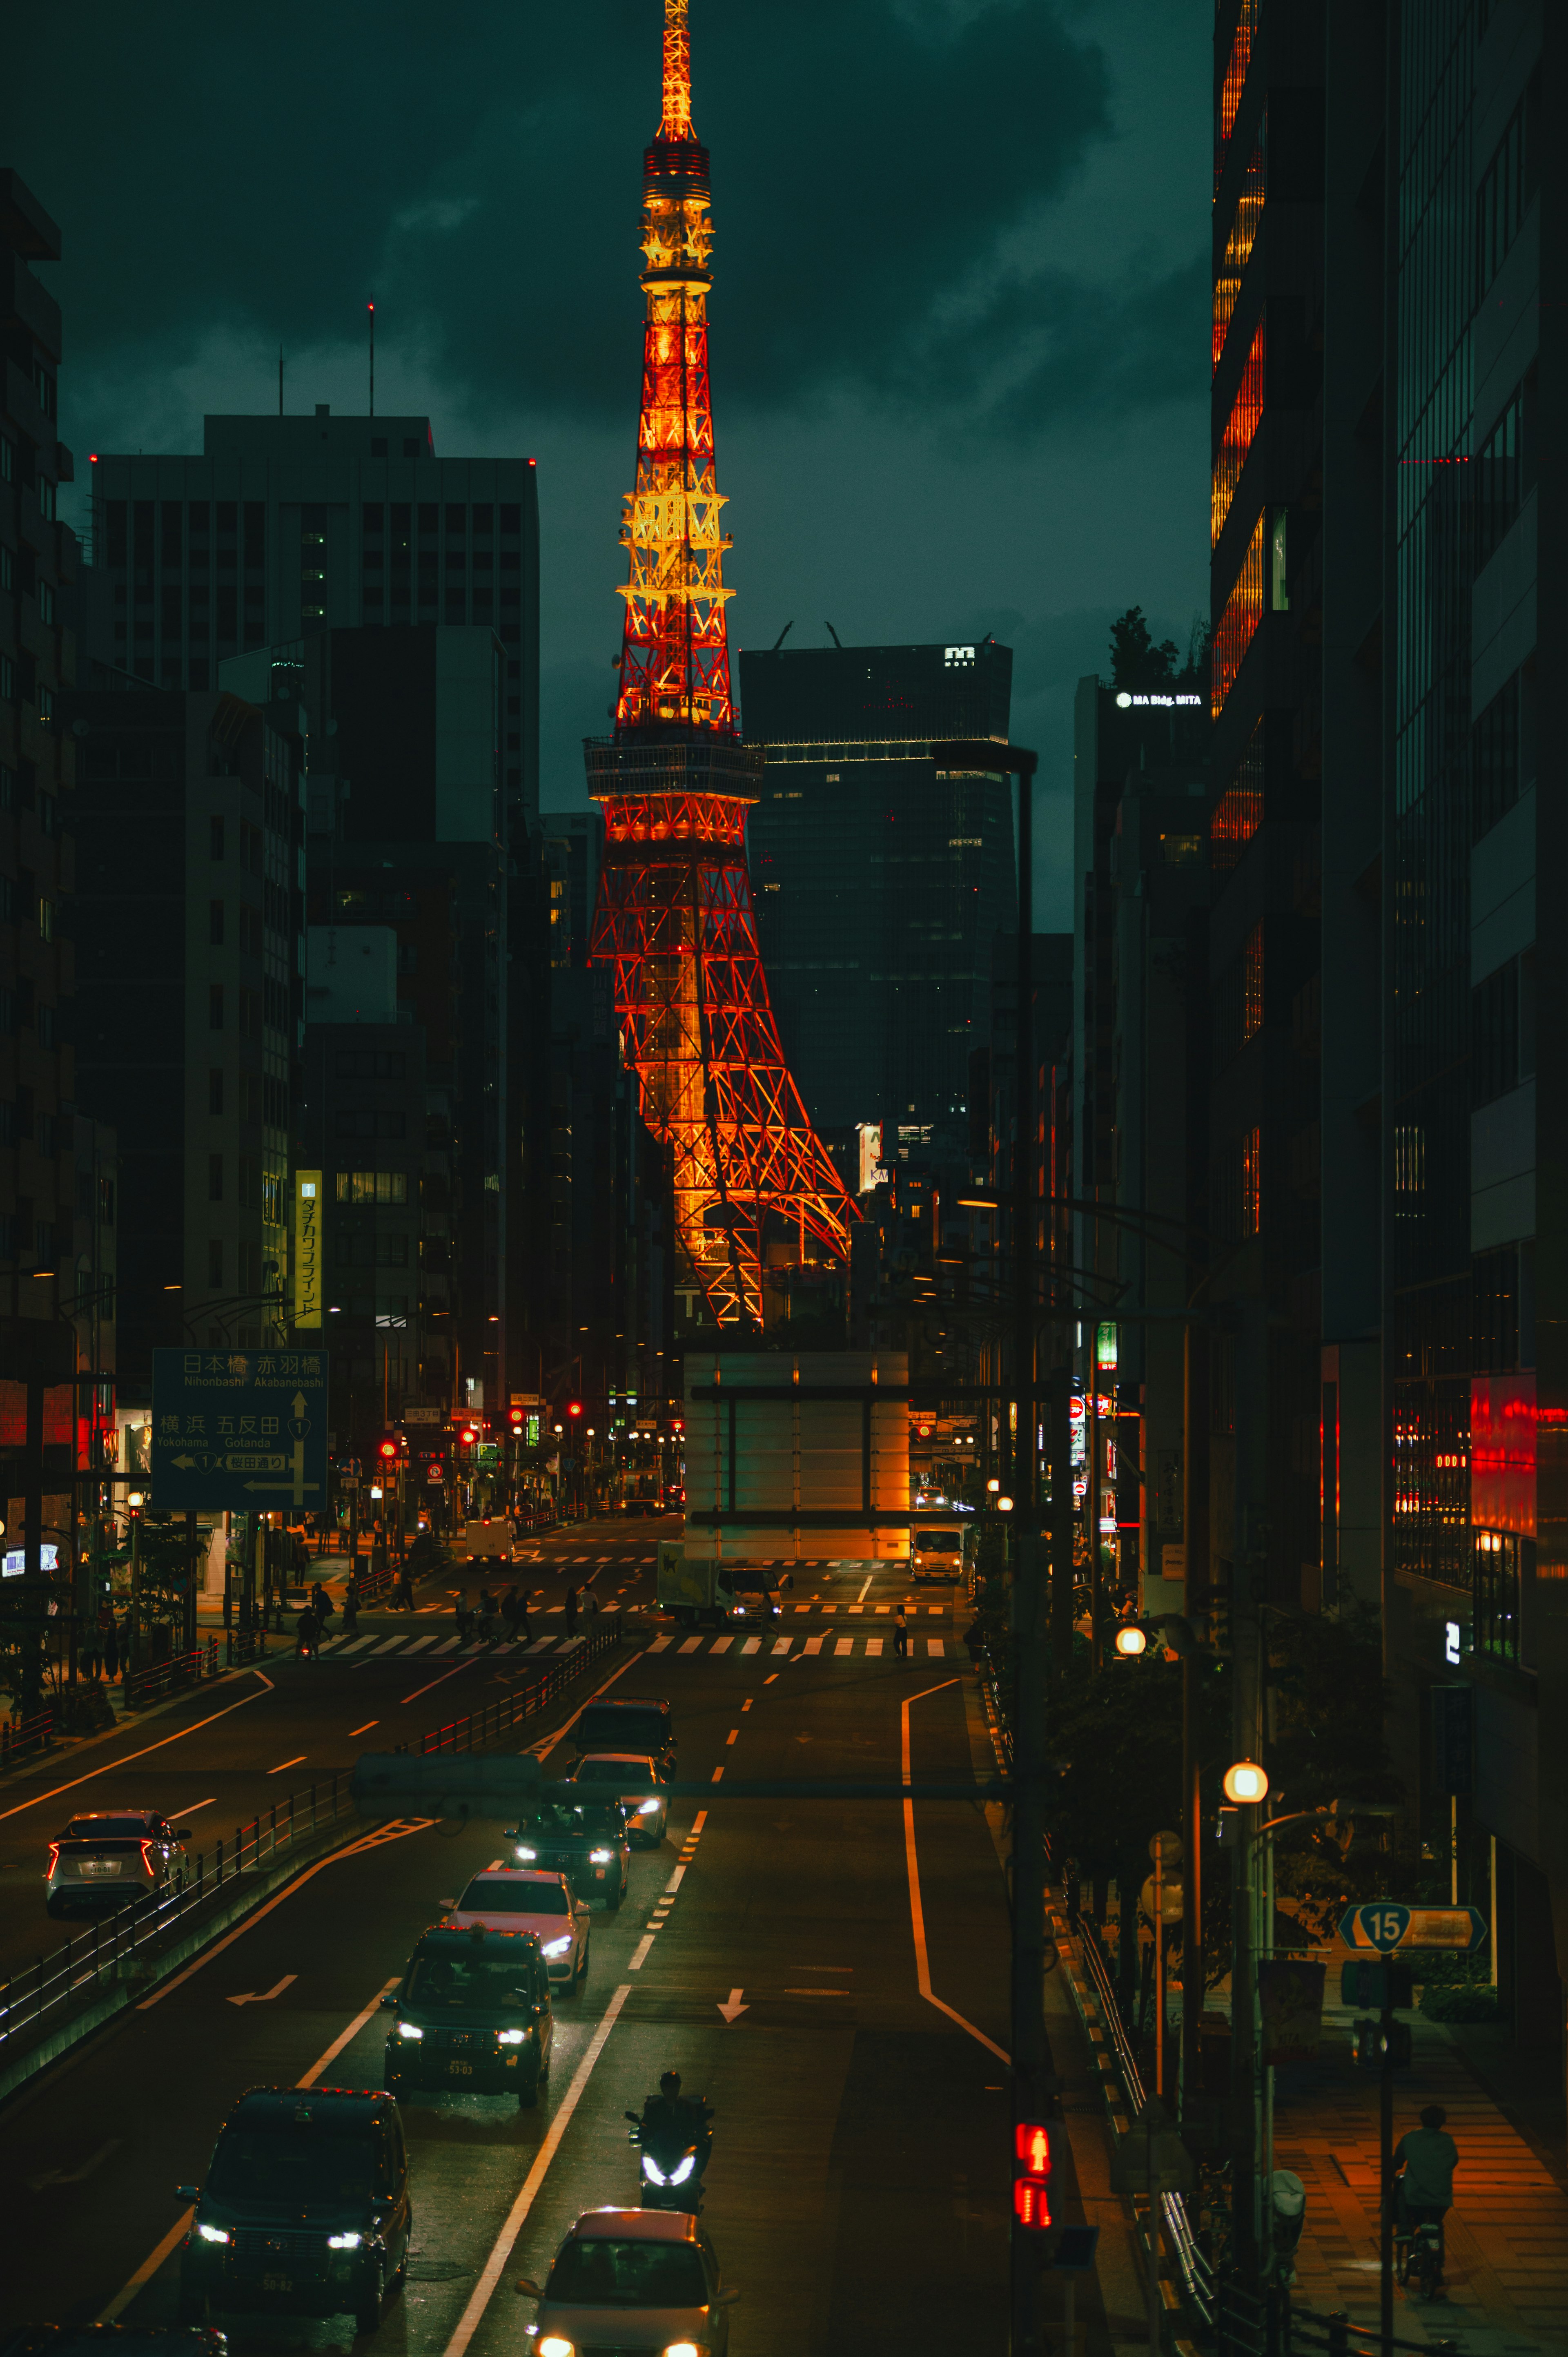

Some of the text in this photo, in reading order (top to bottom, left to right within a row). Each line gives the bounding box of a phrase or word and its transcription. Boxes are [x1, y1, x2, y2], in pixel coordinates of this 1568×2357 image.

[1133, 695, 1202, 706] MA Bldg. MITA
[302, 1199, 316, 1315] タチカワブラインド
[184, 1354, 321, 1375] 日本橋 赤羽橋
[185, 1376, 323, 1387] Nihonbashi Akabanebashi
[160, 1415, 279, 1435] 横浜 五反田
[296, 1422, 301, 1434] 1
[157, 1437, 270, 1448] Yokohama Gotanda
[480, 1445, 488, 1456] P
[202, 1456, 207, 1467] 1
[231, 1456, 282, 1469] 桜田通り
[1370, 1911, 1400, 1941] 15
[450, 2065, 472, 2075] 53-03
